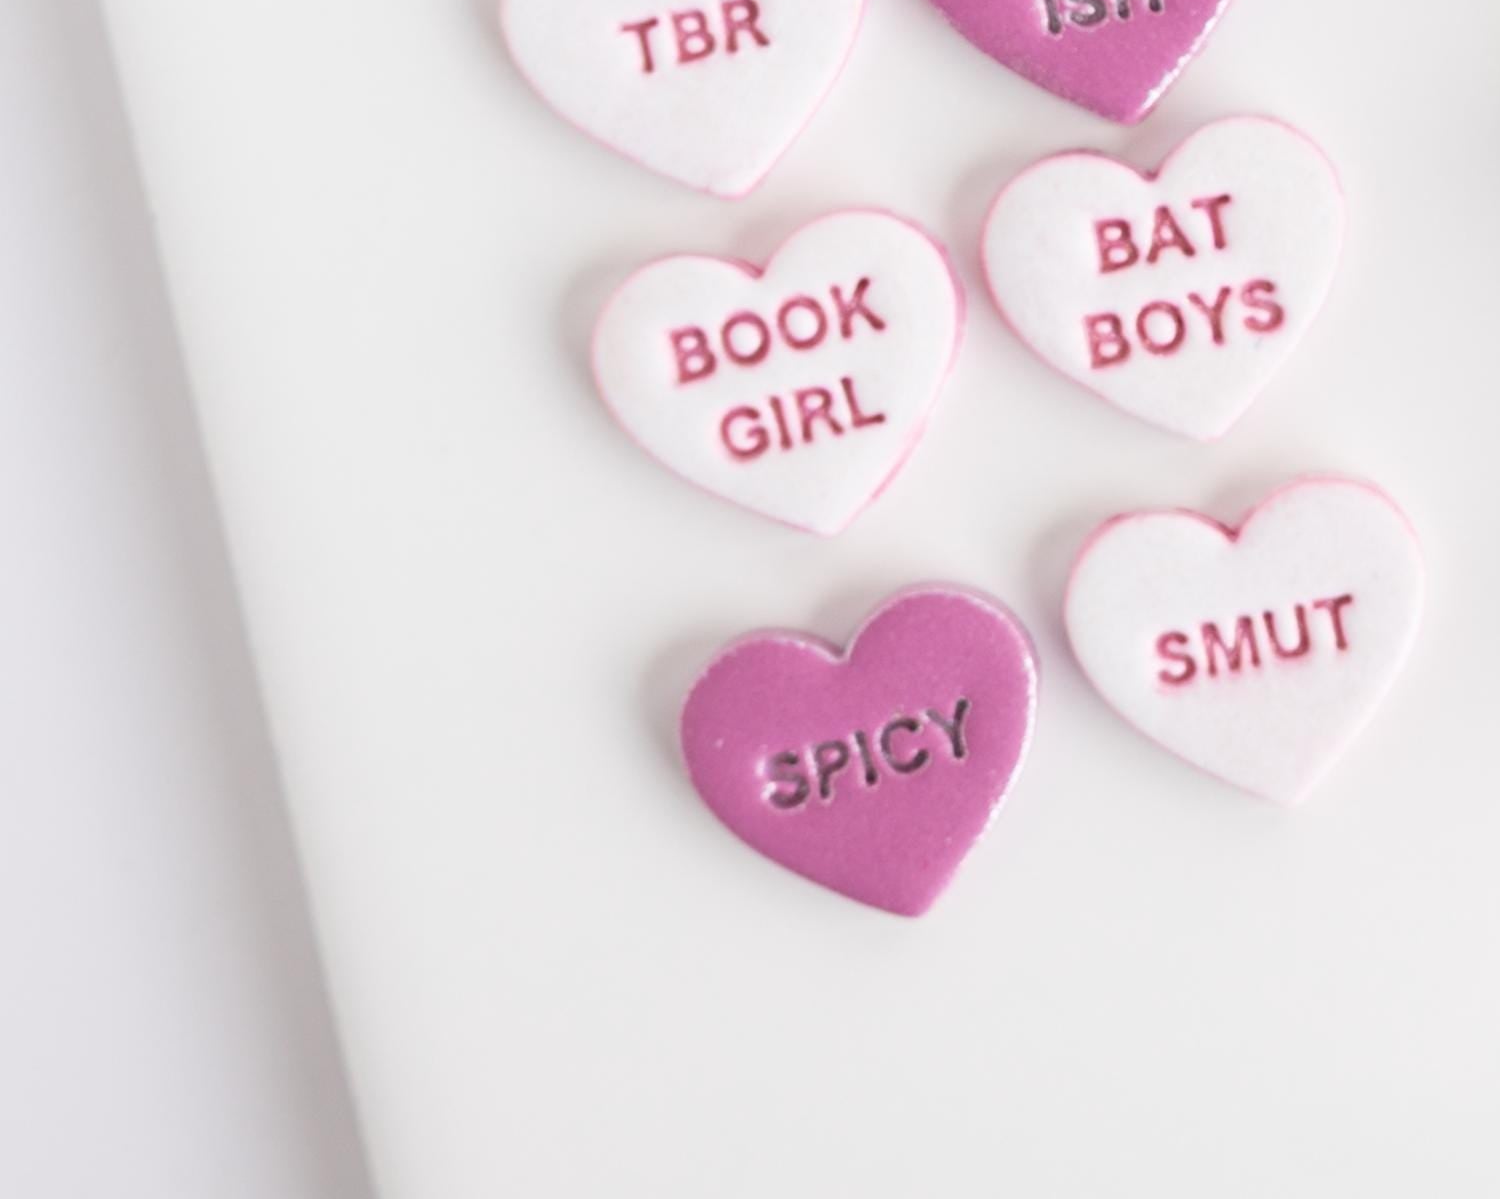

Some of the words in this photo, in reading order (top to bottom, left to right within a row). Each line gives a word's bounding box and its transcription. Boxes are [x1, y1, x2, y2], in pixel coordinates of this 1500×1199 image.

[1094, 193, 1232, 274] BAT
[668, 277, 885, 385] BOOK
[1083, 279, 1285, 369] BOYS
[719, 376, 885, 462] GIRL
[1155, 594, 1353, 686] SMUT
[765, 699, 970, 810] SPICY
